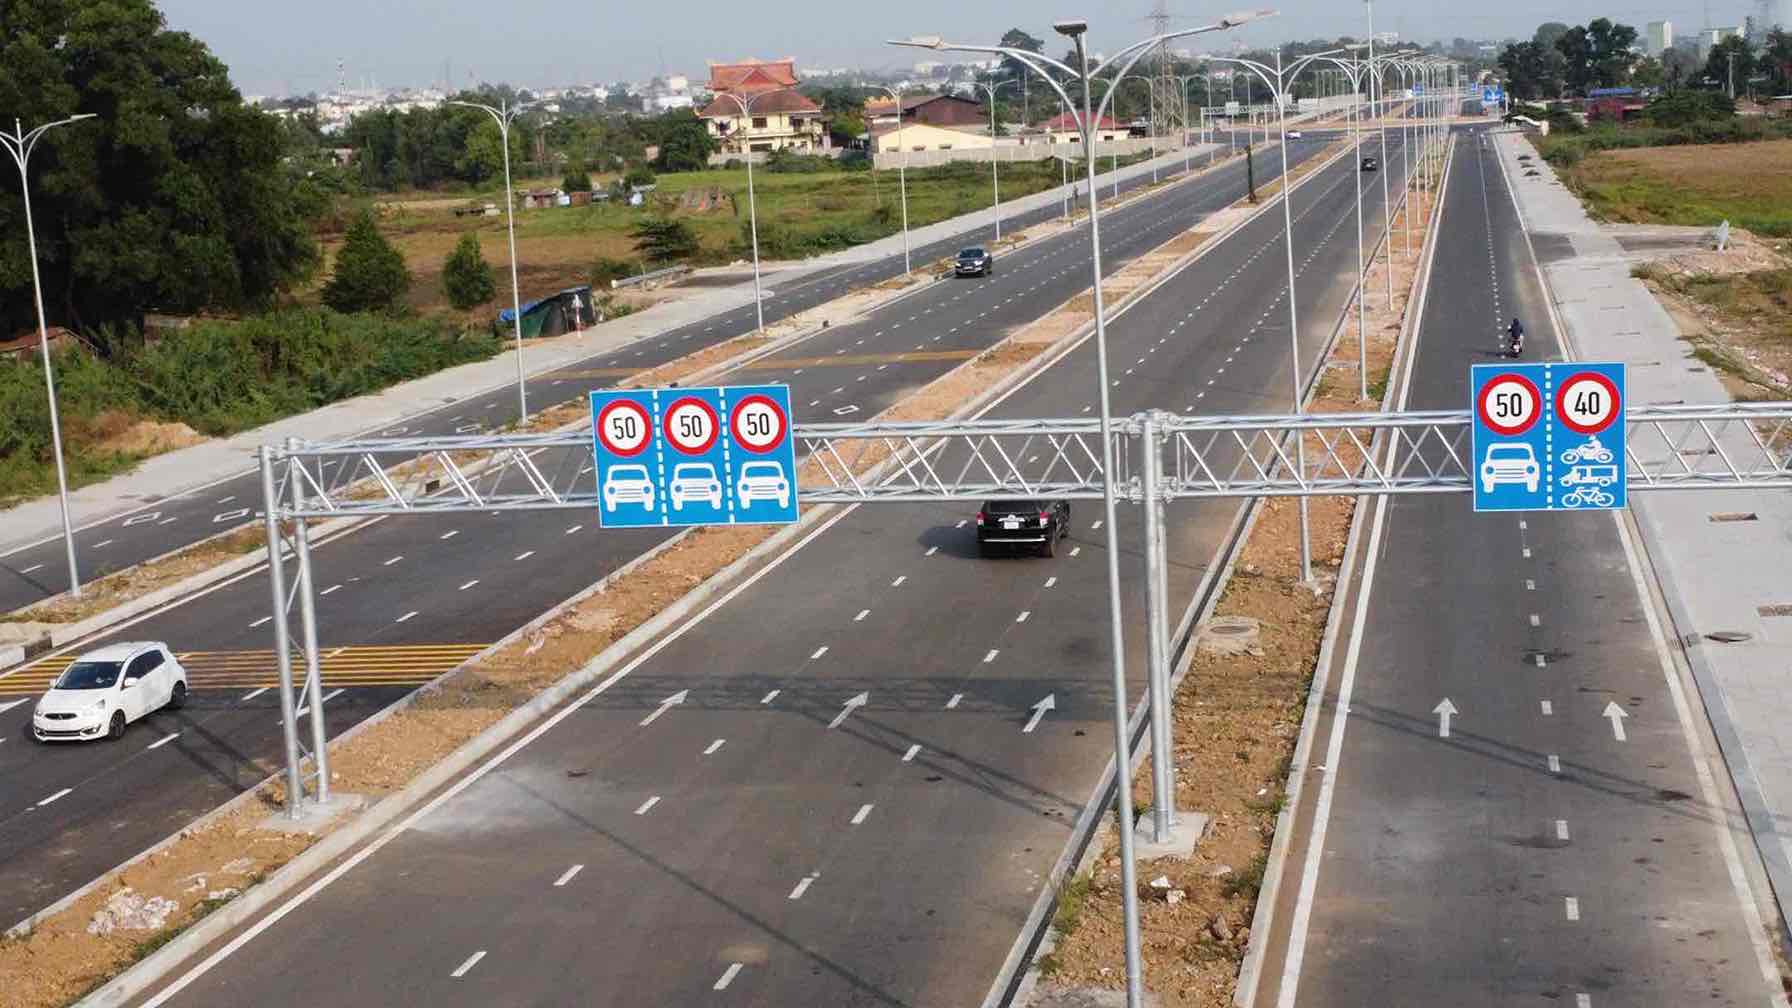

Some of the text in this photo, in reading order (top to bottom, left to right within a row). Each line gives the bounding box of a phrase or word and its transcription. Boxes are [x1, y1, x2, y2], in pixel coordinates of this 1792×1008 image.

[1496, 393, 1522, 417] 50
[1574, 391, 1600, 416] 40
[613, 416, 636, 439] 50
[680, 415, 702, 438] 50
[747, 412, 770, 436] 50
